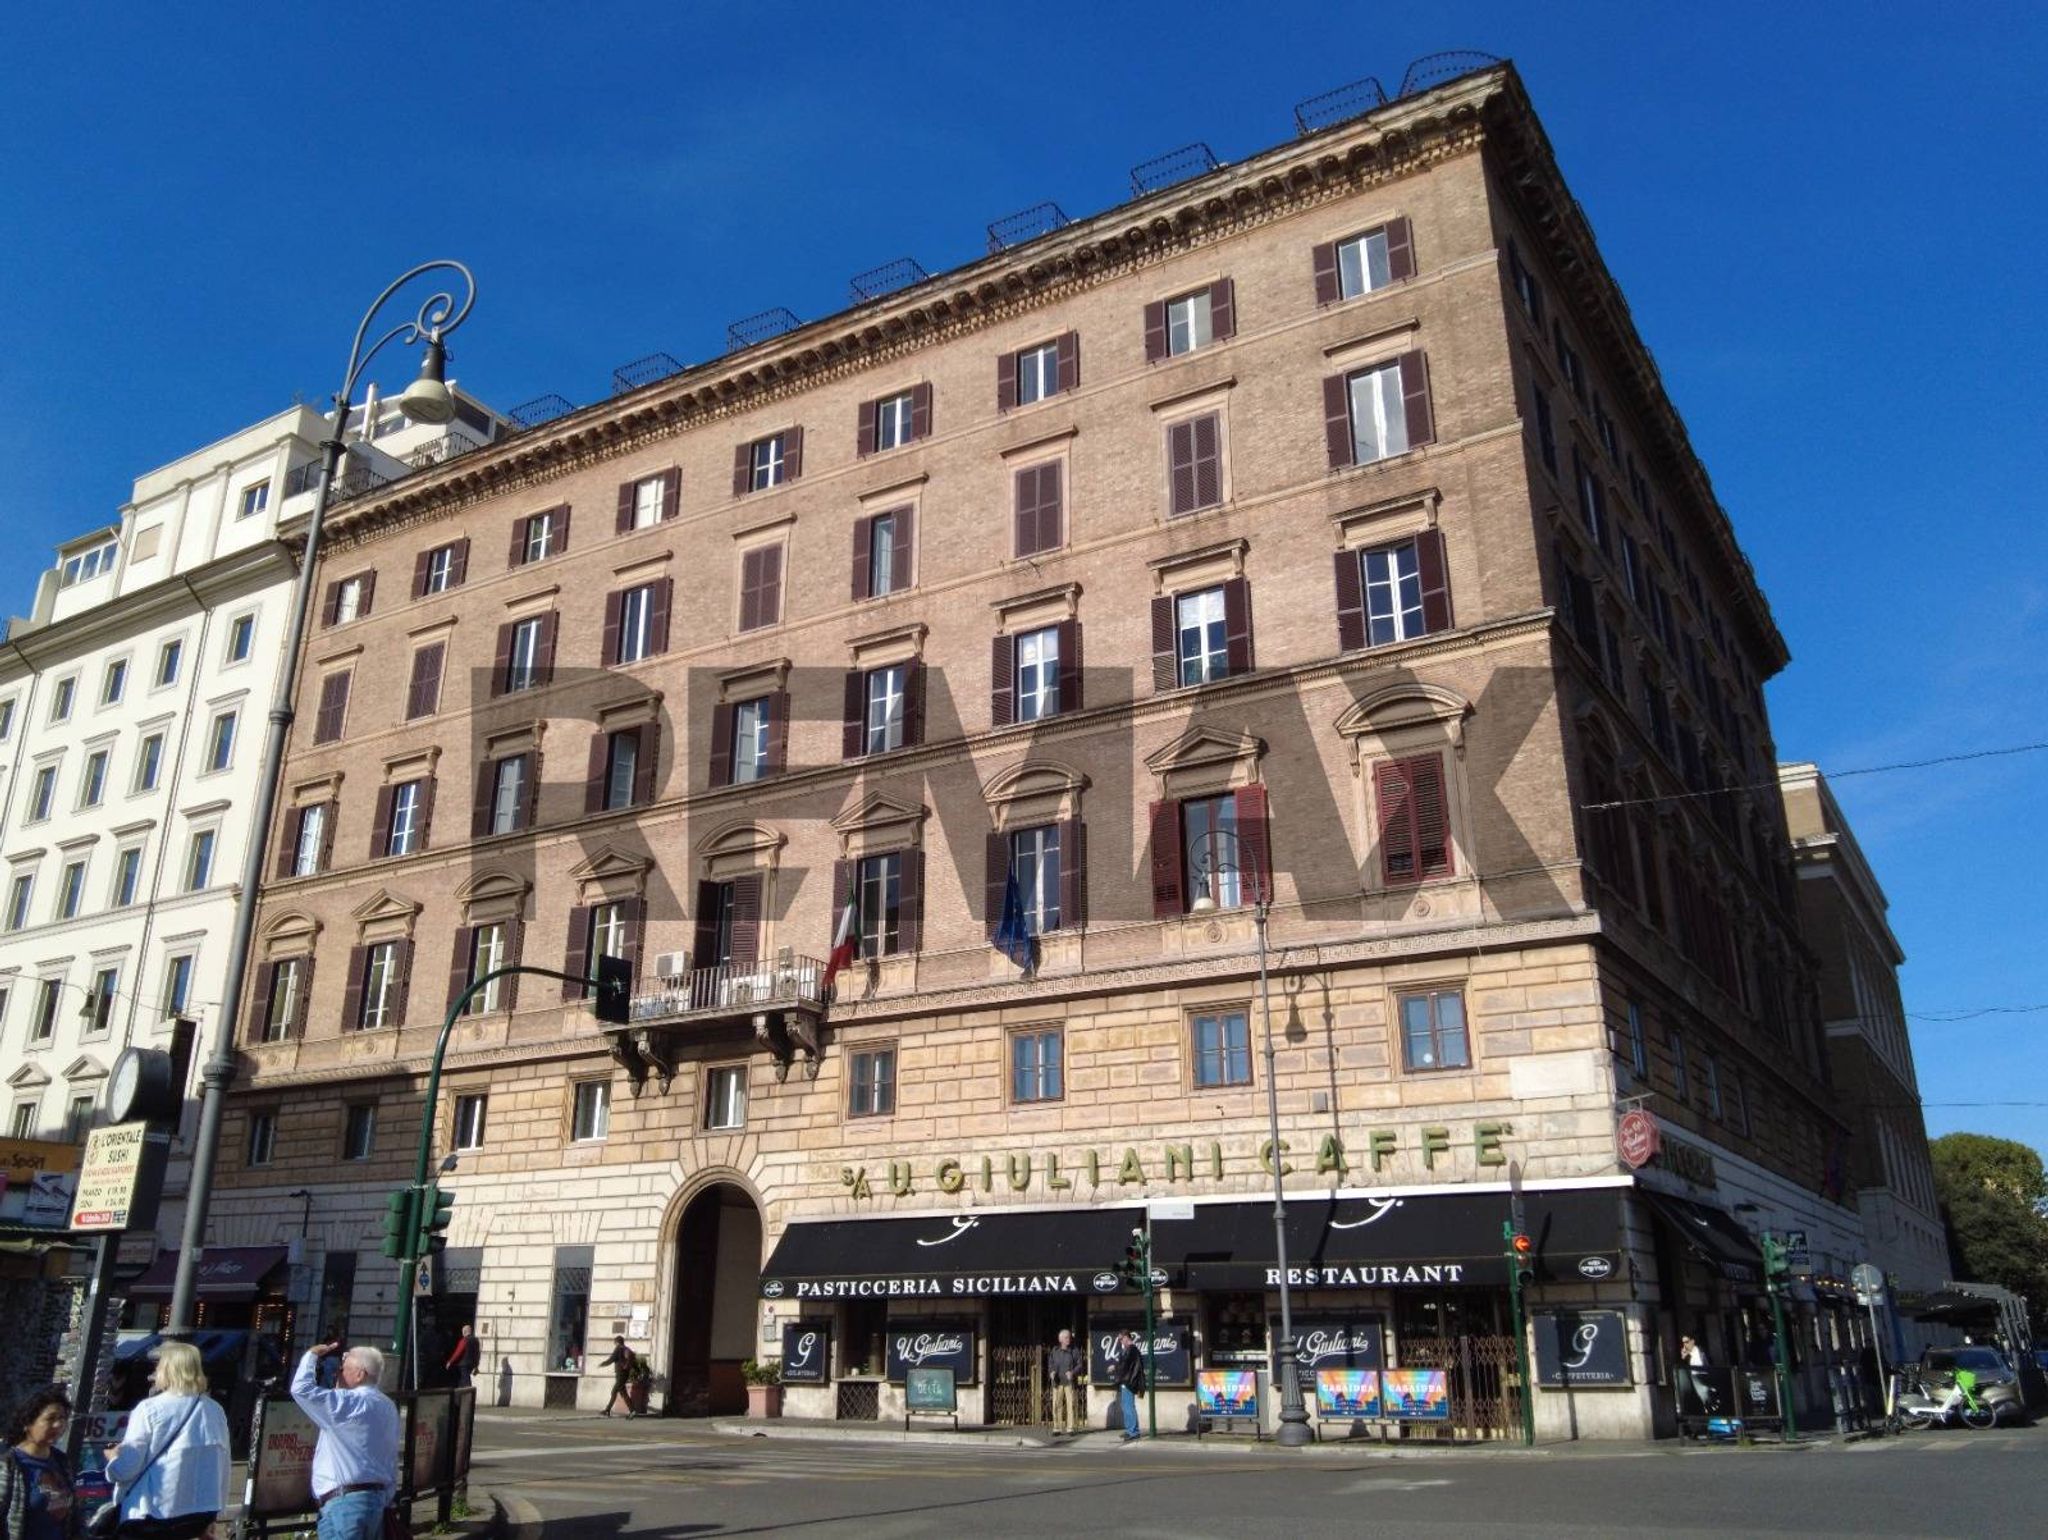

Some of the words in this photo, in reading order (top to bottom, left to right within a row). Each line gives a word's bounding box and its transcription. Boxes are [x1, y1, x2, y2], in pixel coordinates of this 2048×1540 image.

[888, 1158, 917, 1197] U.
[935, 1140, 1224, 1195] GIULIANI
[796, 1278, 942, 1297] PASTICCERIA
[952, 1274, 1078, 1294] SICILIANA
[1265, 1263, 1464, 1286] RESTAURANT
